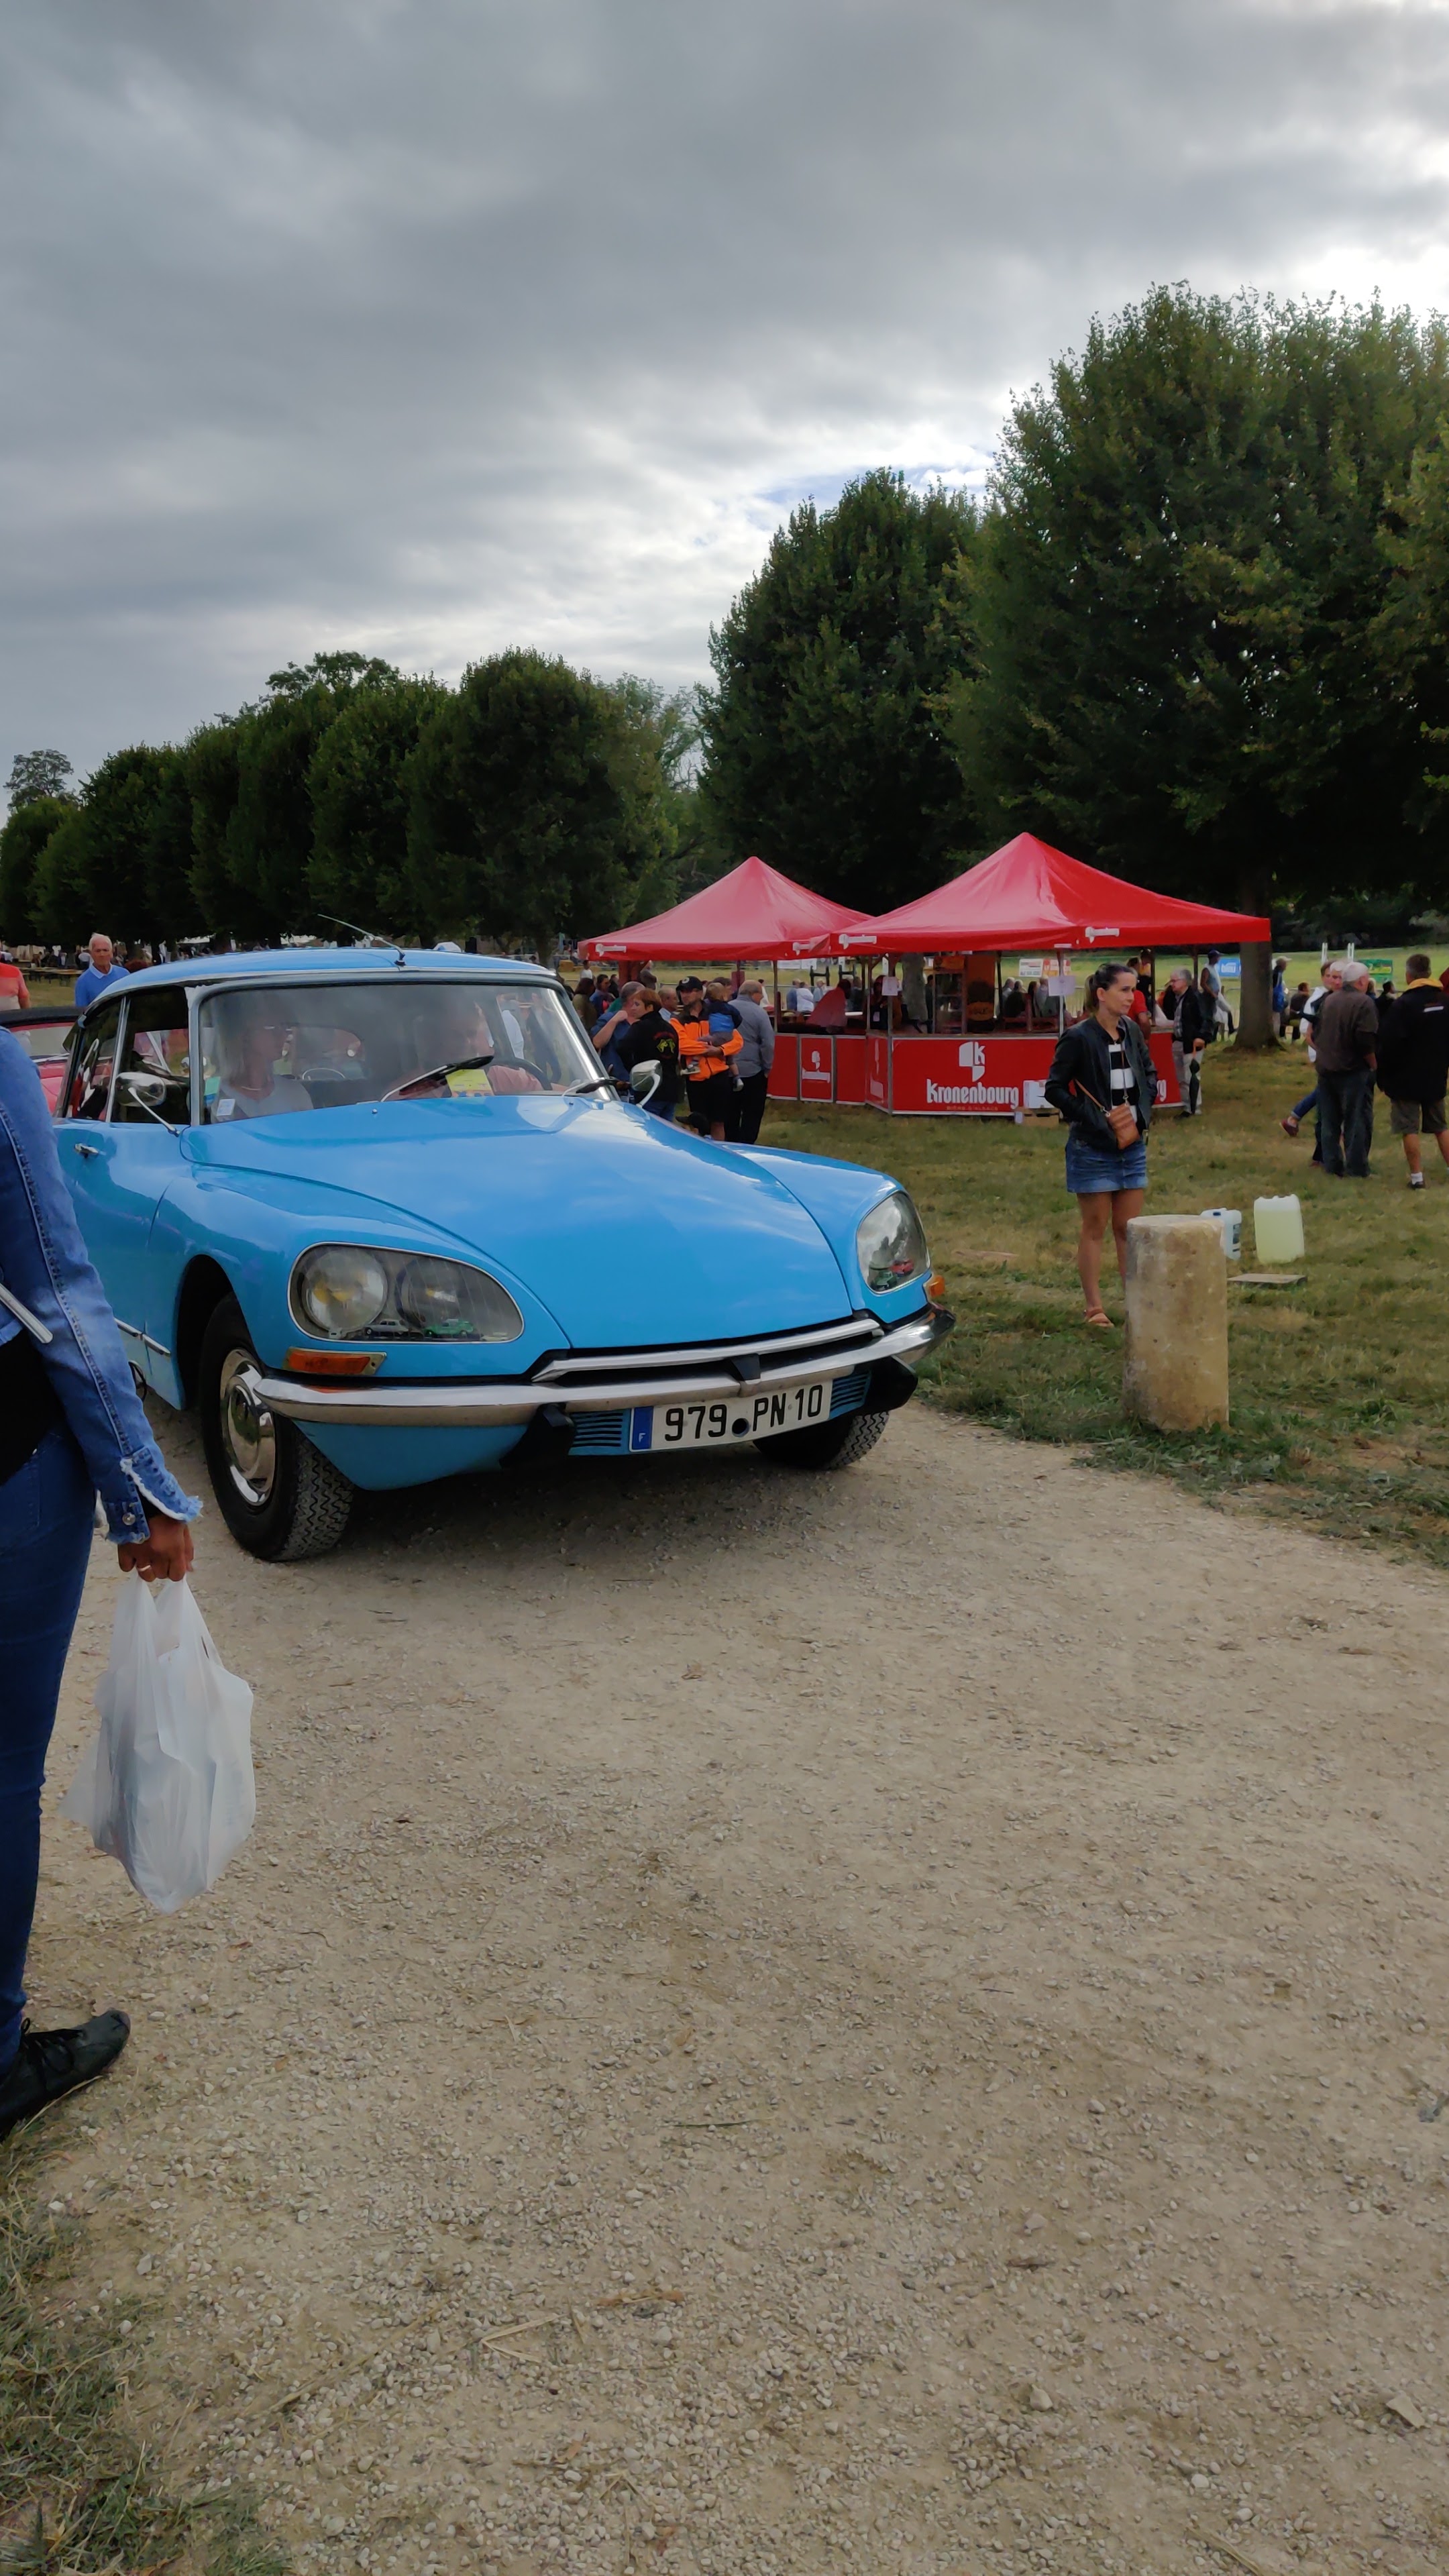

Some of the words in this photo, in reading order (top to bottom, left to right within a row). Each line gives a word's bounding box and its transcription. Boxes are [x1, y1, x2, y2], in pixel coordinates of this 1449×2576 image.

[926, 1078, 1019, 1110] Kronenbourg
[665, 1404, 727, 1442] 979
[752, 1393, 787, 1432] PN
[795, 1385, 823, 1420] 10
